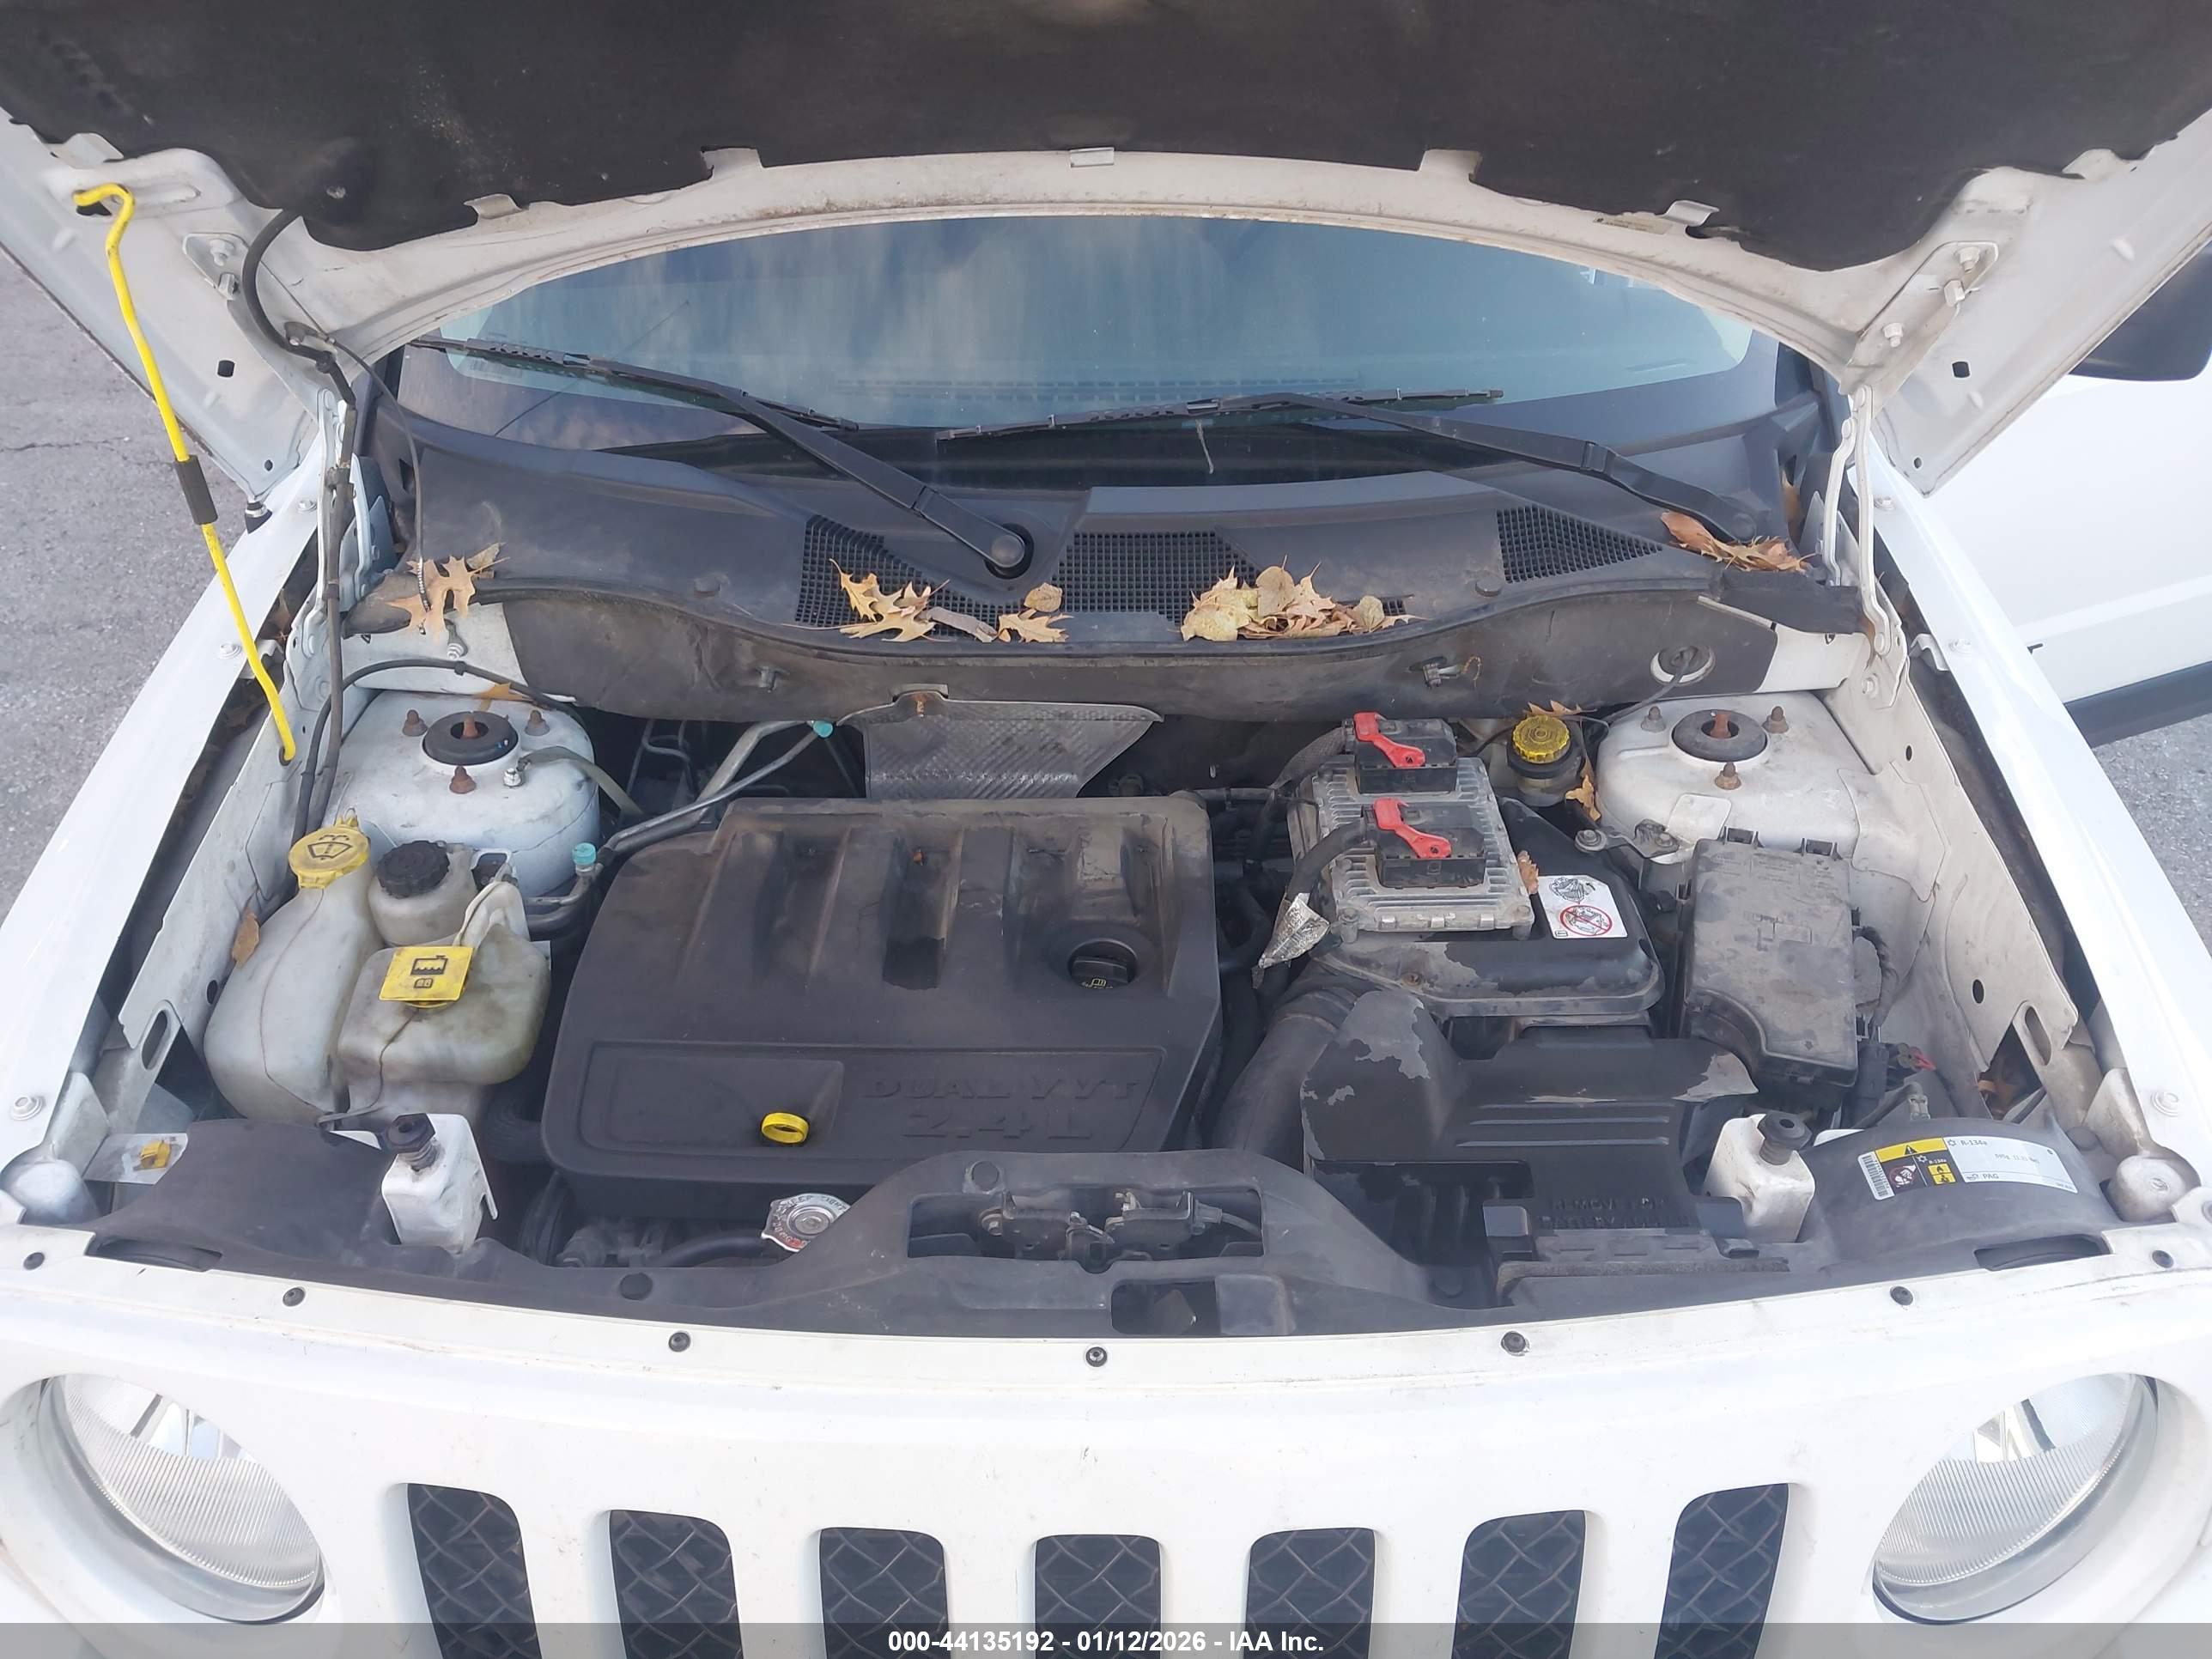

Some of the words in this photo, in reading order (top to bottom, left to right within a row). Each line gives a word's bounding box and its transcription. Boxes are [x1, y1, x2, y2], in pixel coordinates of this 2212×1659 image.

[860, 1077, 1011, 1100] DUAL
[1027, 1078, 1141, 1100] VVT
[901, 1105, 1093, 1140] 2.4L
